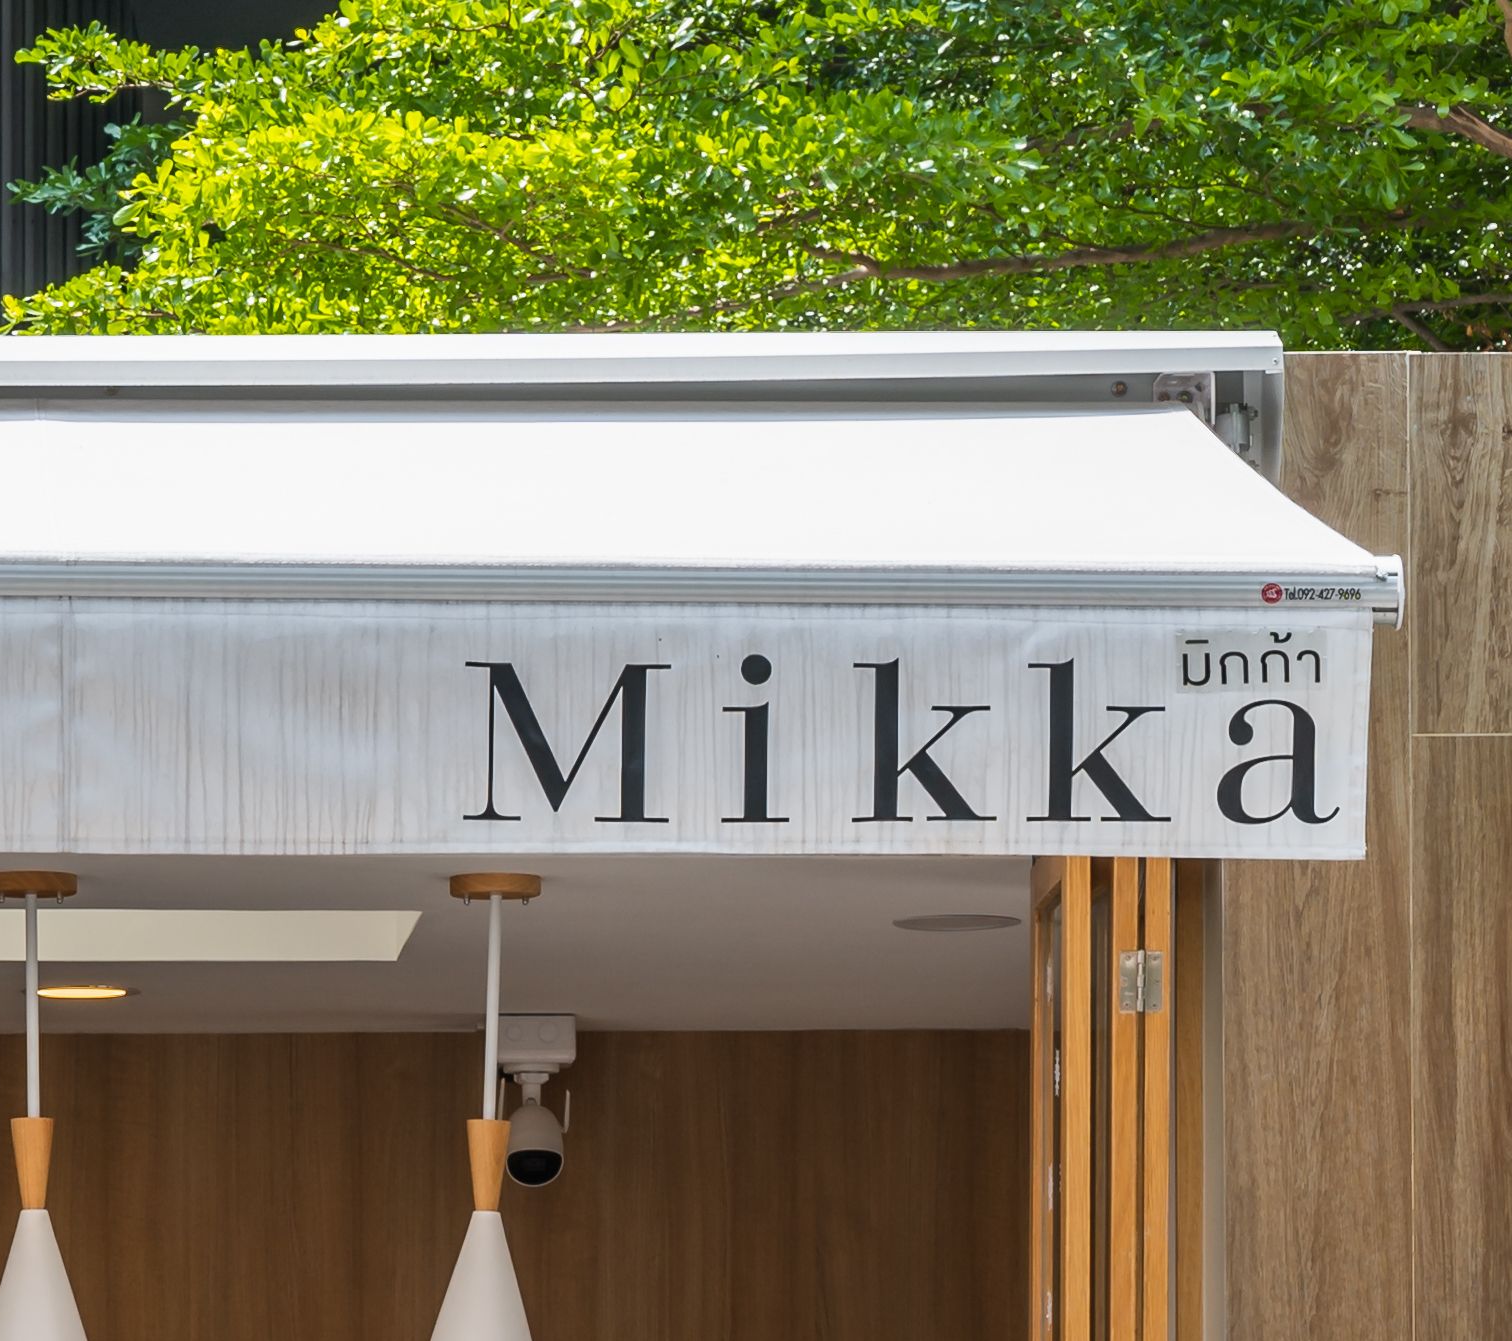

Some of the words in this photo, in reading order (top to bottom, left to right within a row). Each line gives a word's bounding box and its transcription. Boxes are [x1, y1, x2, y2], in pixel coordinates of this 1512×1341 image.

[1182, 632, 1321, 686] มิกก้า
[463, 653, 1340, 825] Mikka
